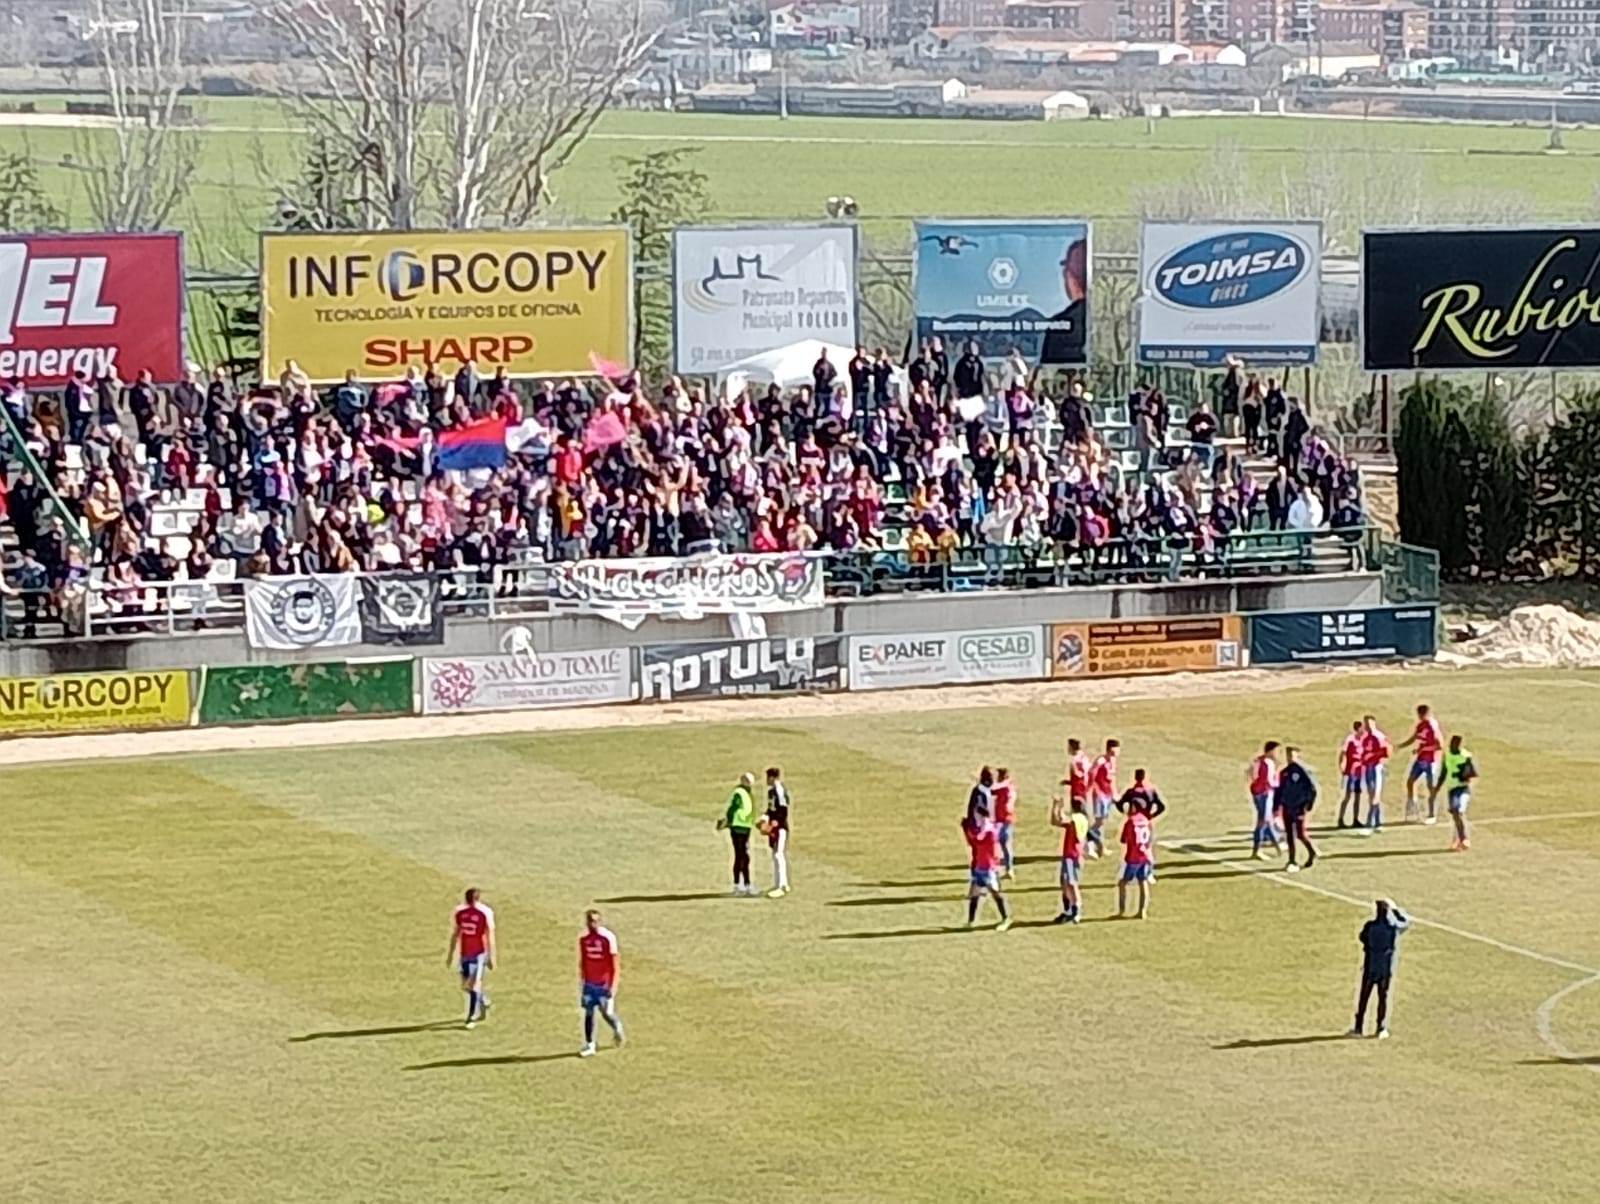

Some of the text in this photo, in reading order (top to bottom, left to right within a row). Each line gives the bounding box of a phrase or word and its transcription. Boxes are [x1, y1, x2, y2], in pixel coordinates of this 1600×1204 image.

[289, 250, 607, 301] INFORCOPY
[1161, 246, 1297, 290] TOIMSA
[416, 309, 425, 319] Y
[429, 307, 495, 320] EQUIPOS
[498, 306, 517, 317] DE
[524, 303, 582, 317] OFICINA
[0, 346, 118, 382] energy
[365, 336, 534, 367] SHARP
[859, 640, 946, 665] EXPANET
[962, 636, 1030, 658] CESAB
[481, 650, 621, 681] SANTO TOMÉ
